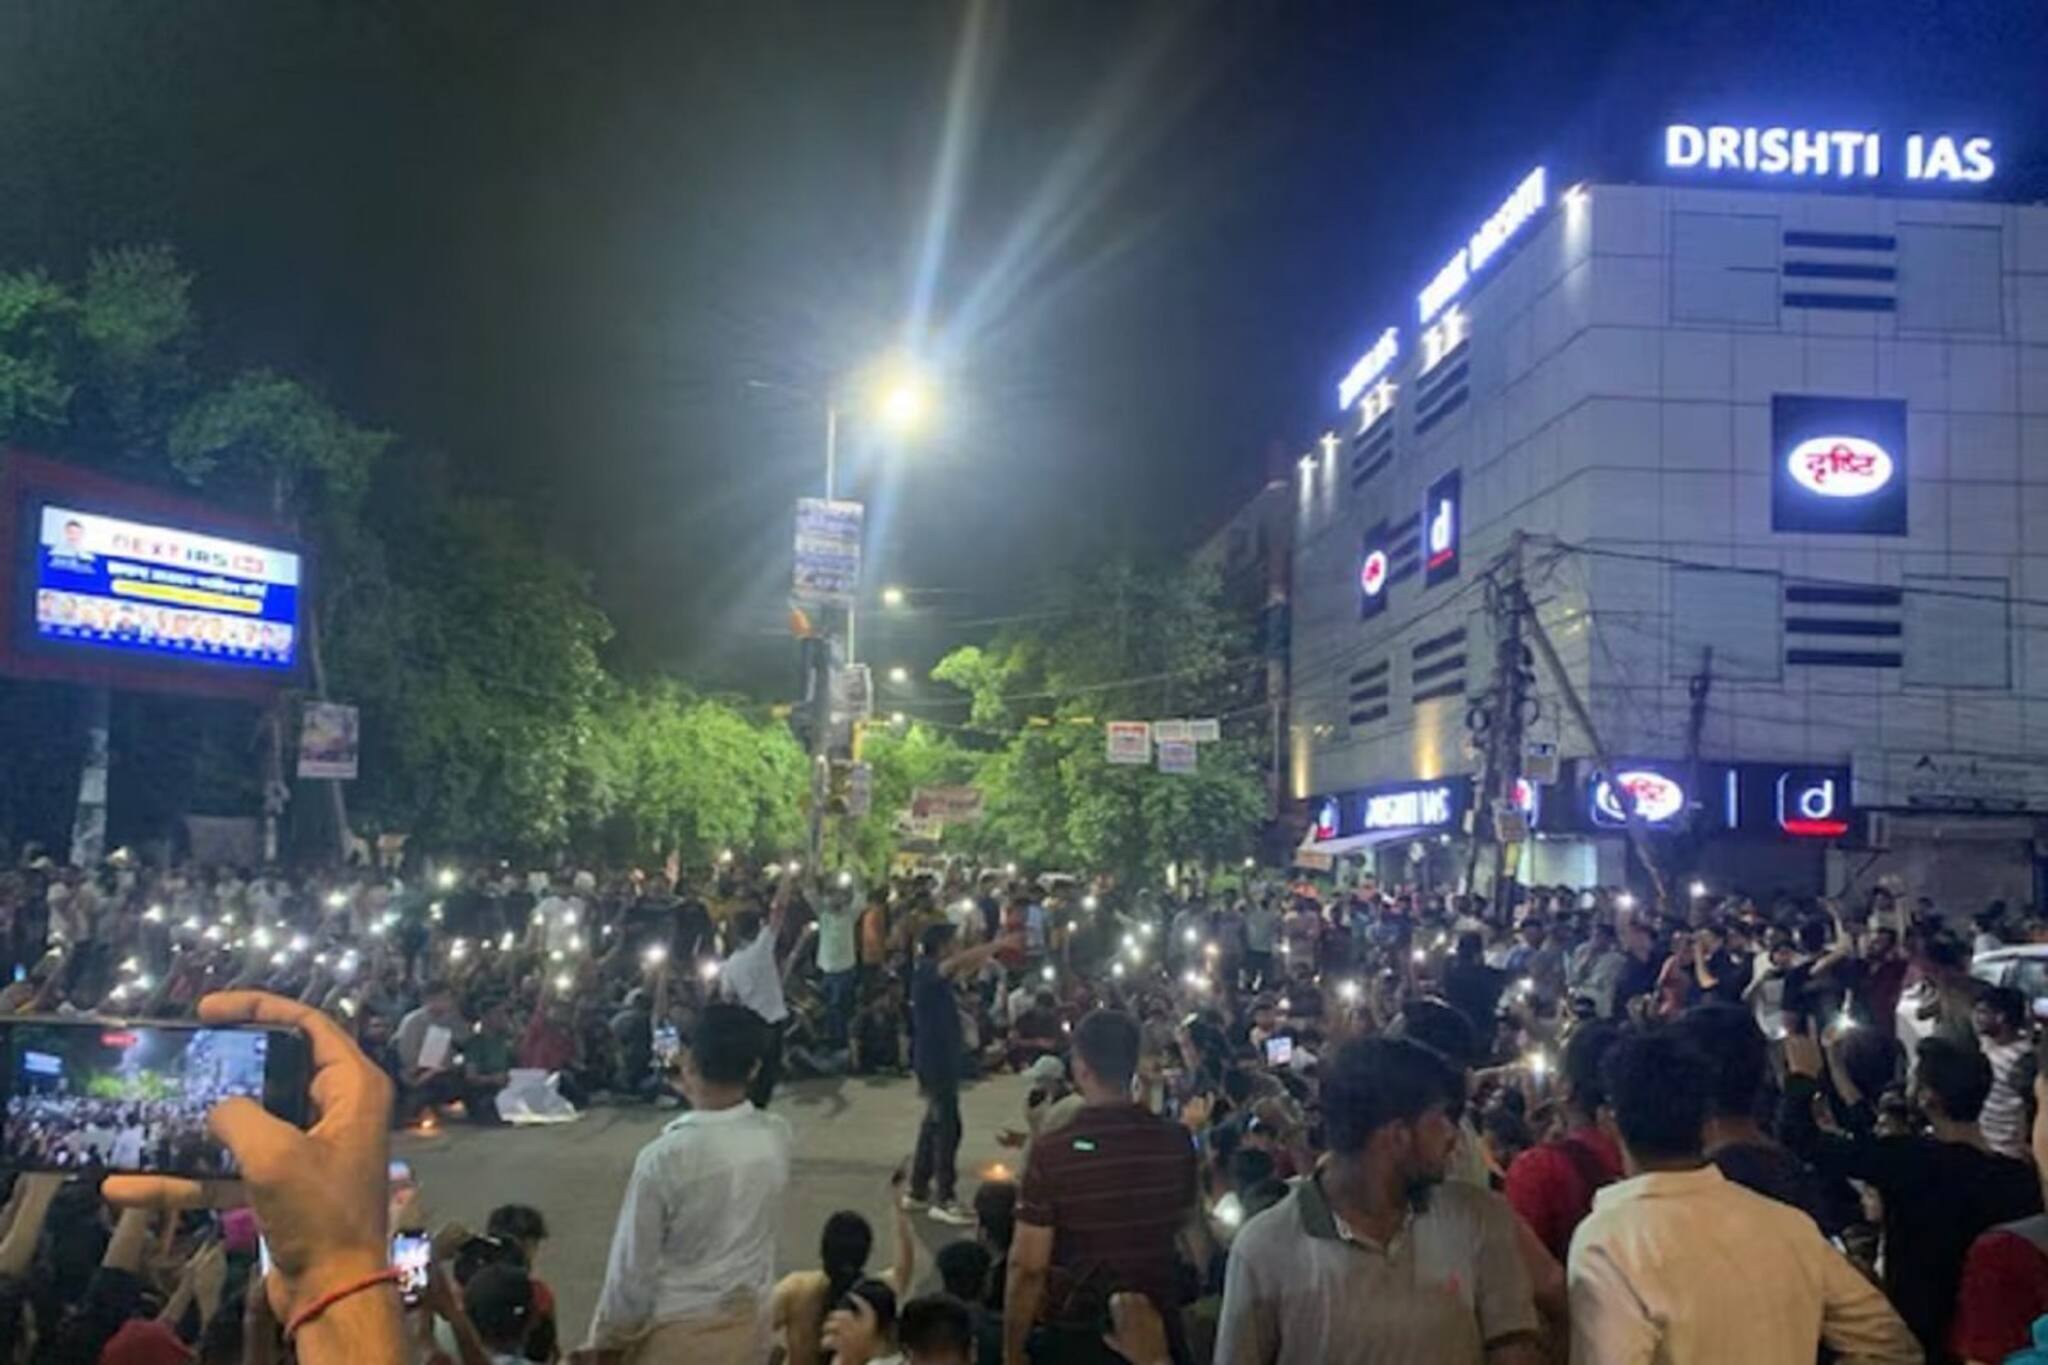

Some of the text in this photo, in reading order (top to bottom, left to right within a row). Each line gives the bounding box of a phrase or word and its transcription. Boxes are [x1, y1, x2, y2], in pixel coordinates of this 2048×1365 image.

[1666, 125, 1995, 182] DRISHTI IAS
[1805, 443, 1877, 484] दृष्टि
[1801, 779, 1834, 819] d
